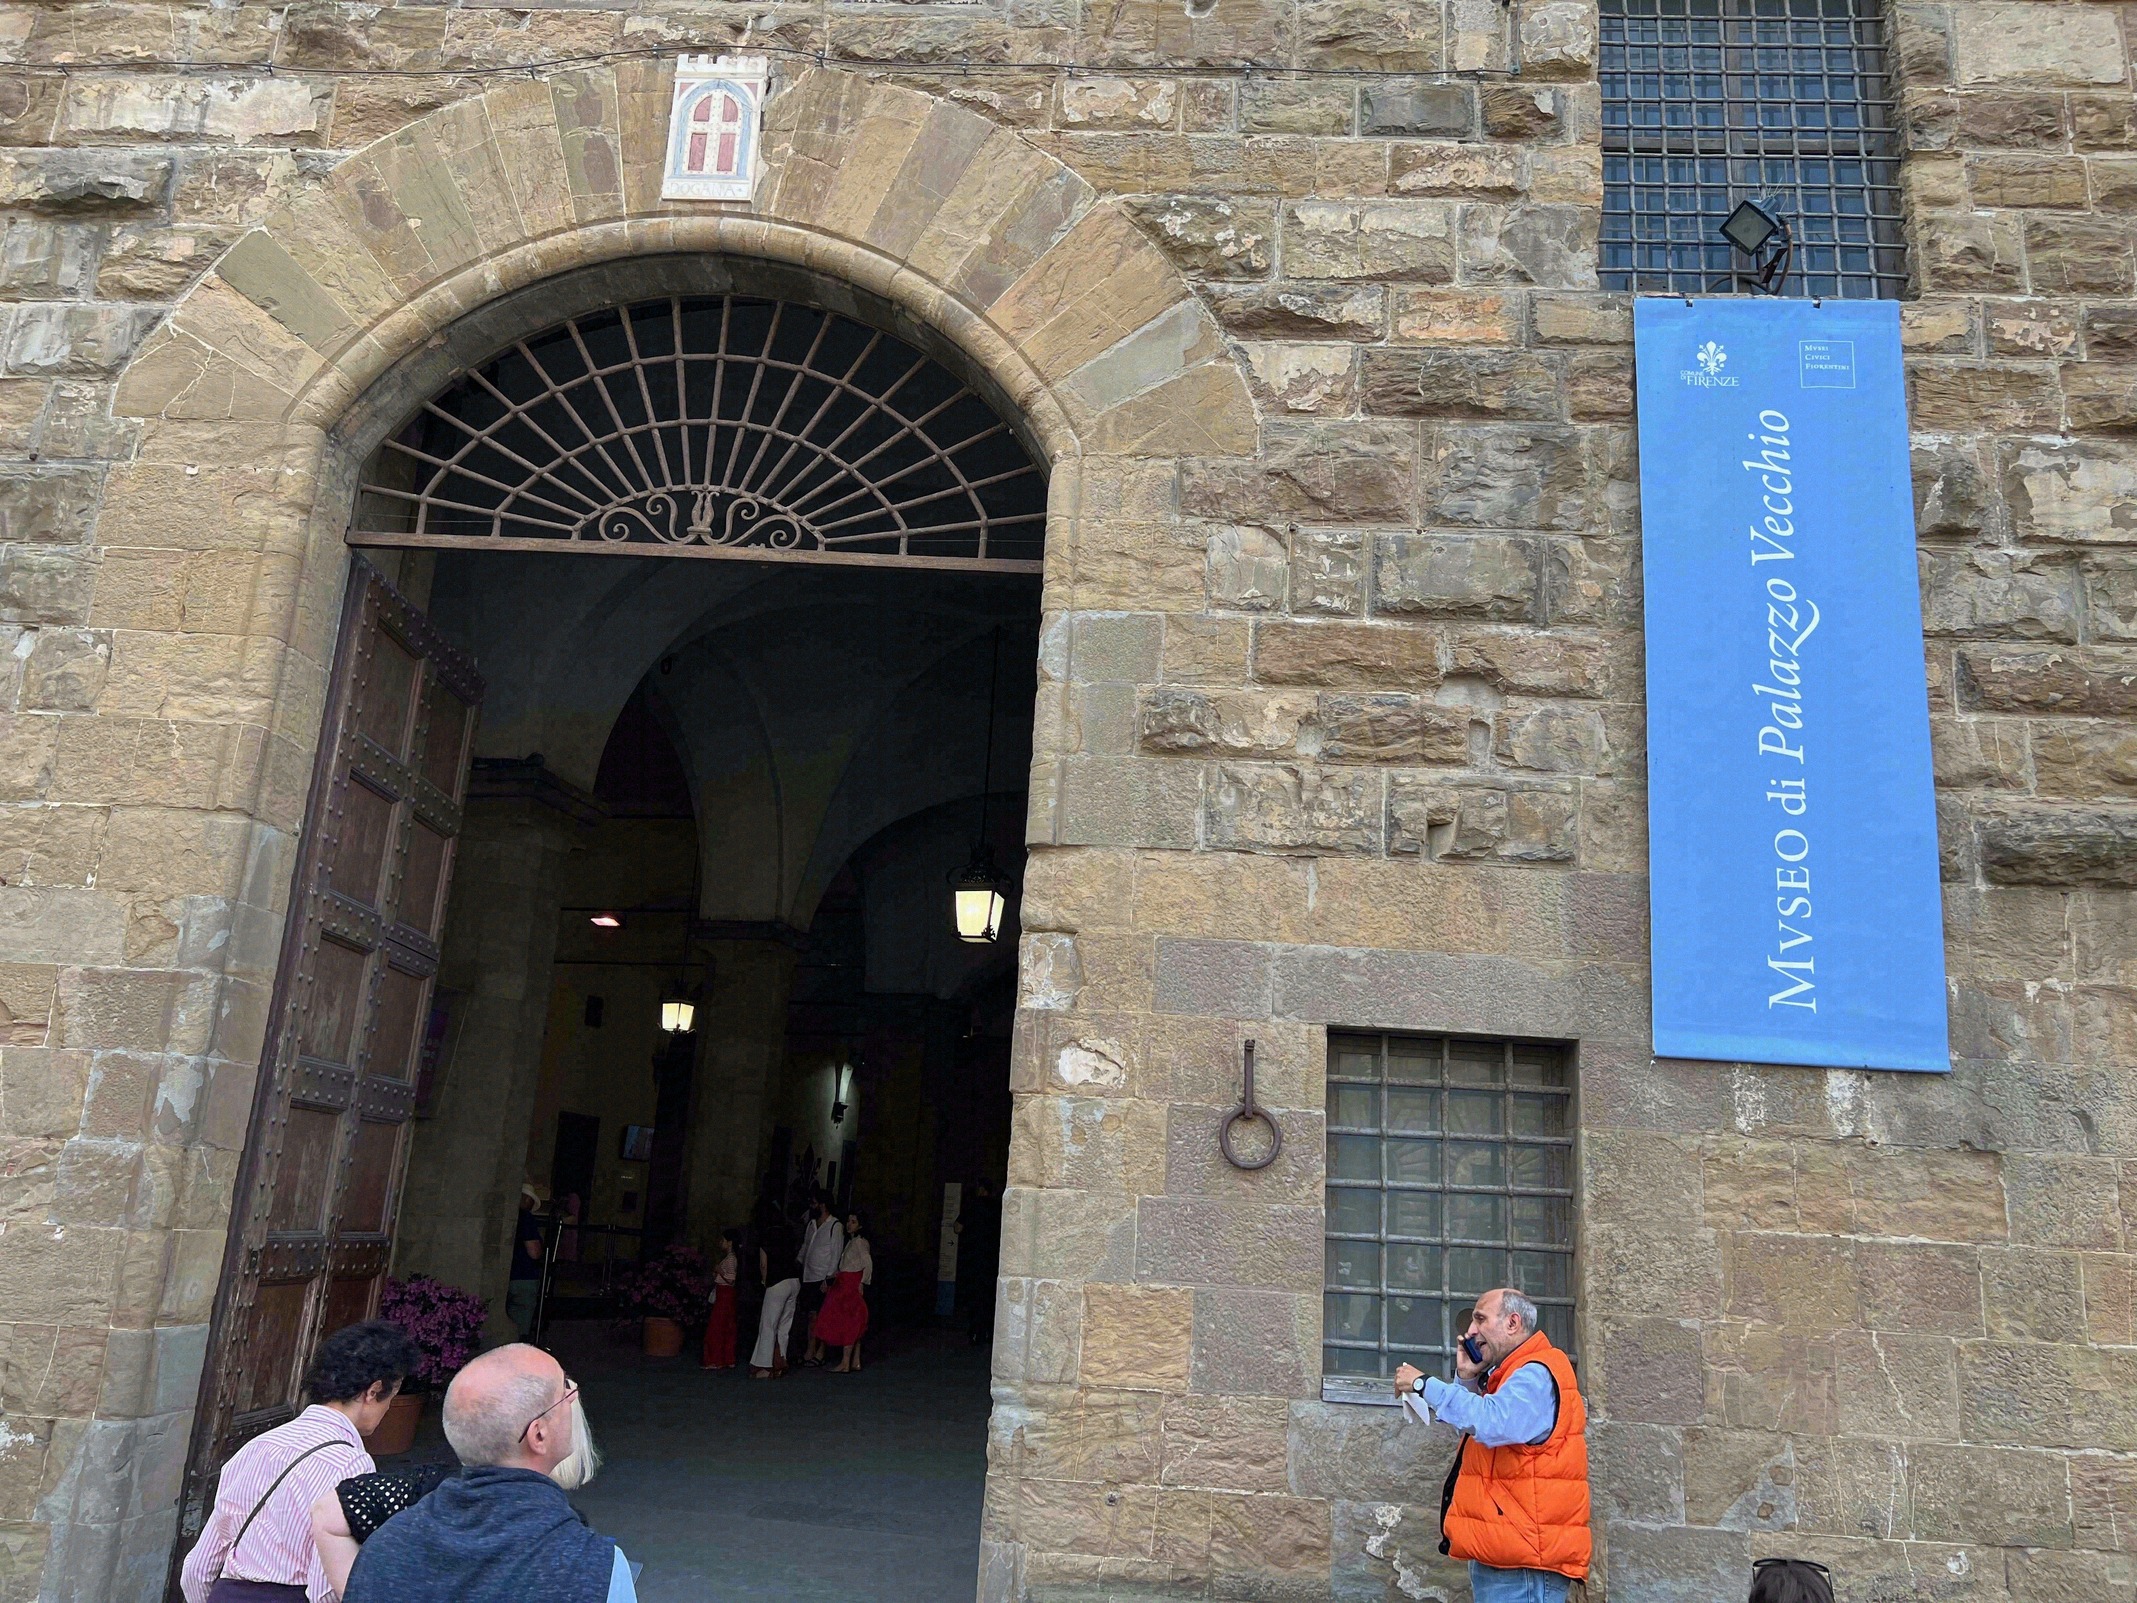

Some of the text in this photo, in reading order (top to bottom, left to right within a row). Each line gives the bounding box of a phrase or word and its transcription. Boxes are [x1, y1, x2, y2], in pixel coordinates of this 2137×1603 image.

[670, 182, 736, 197] DOGANA
[1804, 353, 1831, 361] CIVICI
[1680, 369, 1704, 377] COMUNE
[1687, 375, 1740, 389] FIRENZE
[1742, 409, 1820, 1014] MVSEO di Palazzo Vecchio
